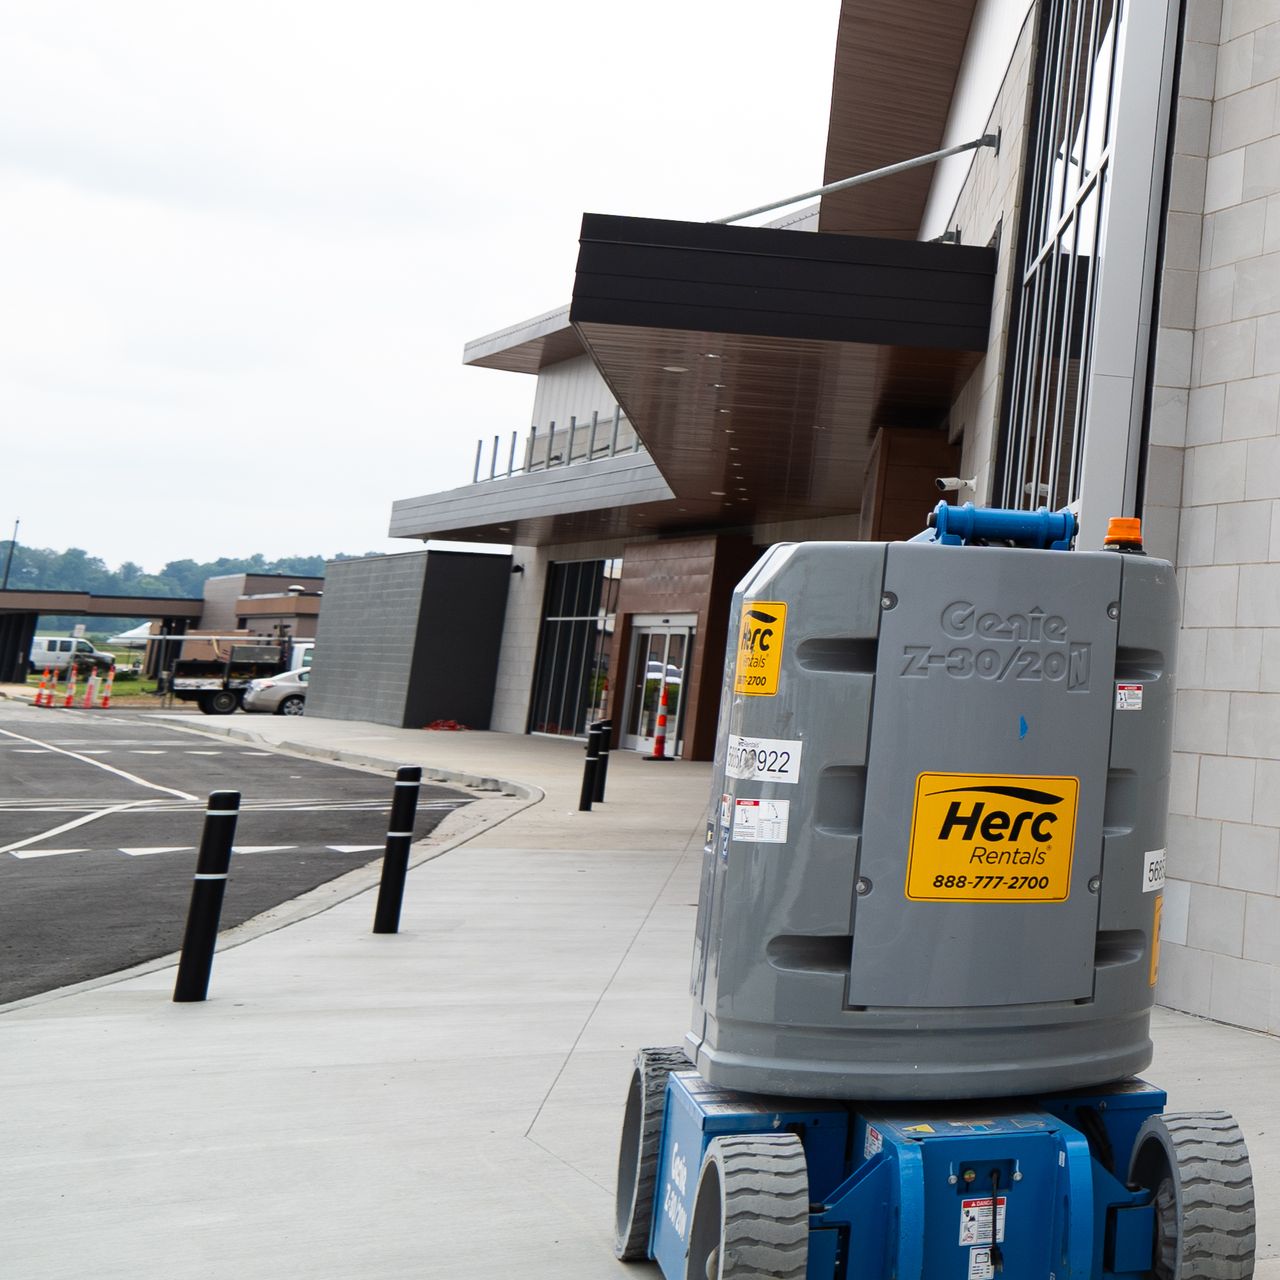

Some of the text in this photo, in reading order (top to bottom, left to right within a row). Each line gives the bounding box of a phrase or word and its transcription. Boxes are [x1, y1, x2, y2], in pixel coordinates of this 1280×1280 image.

[940, 600, 1068, 643] Genie
[937, 801, 1058, 843] Herc
[969, 846, 1047, 865] Rentals
[933, 874, 1049, 889] 888-777-2700
